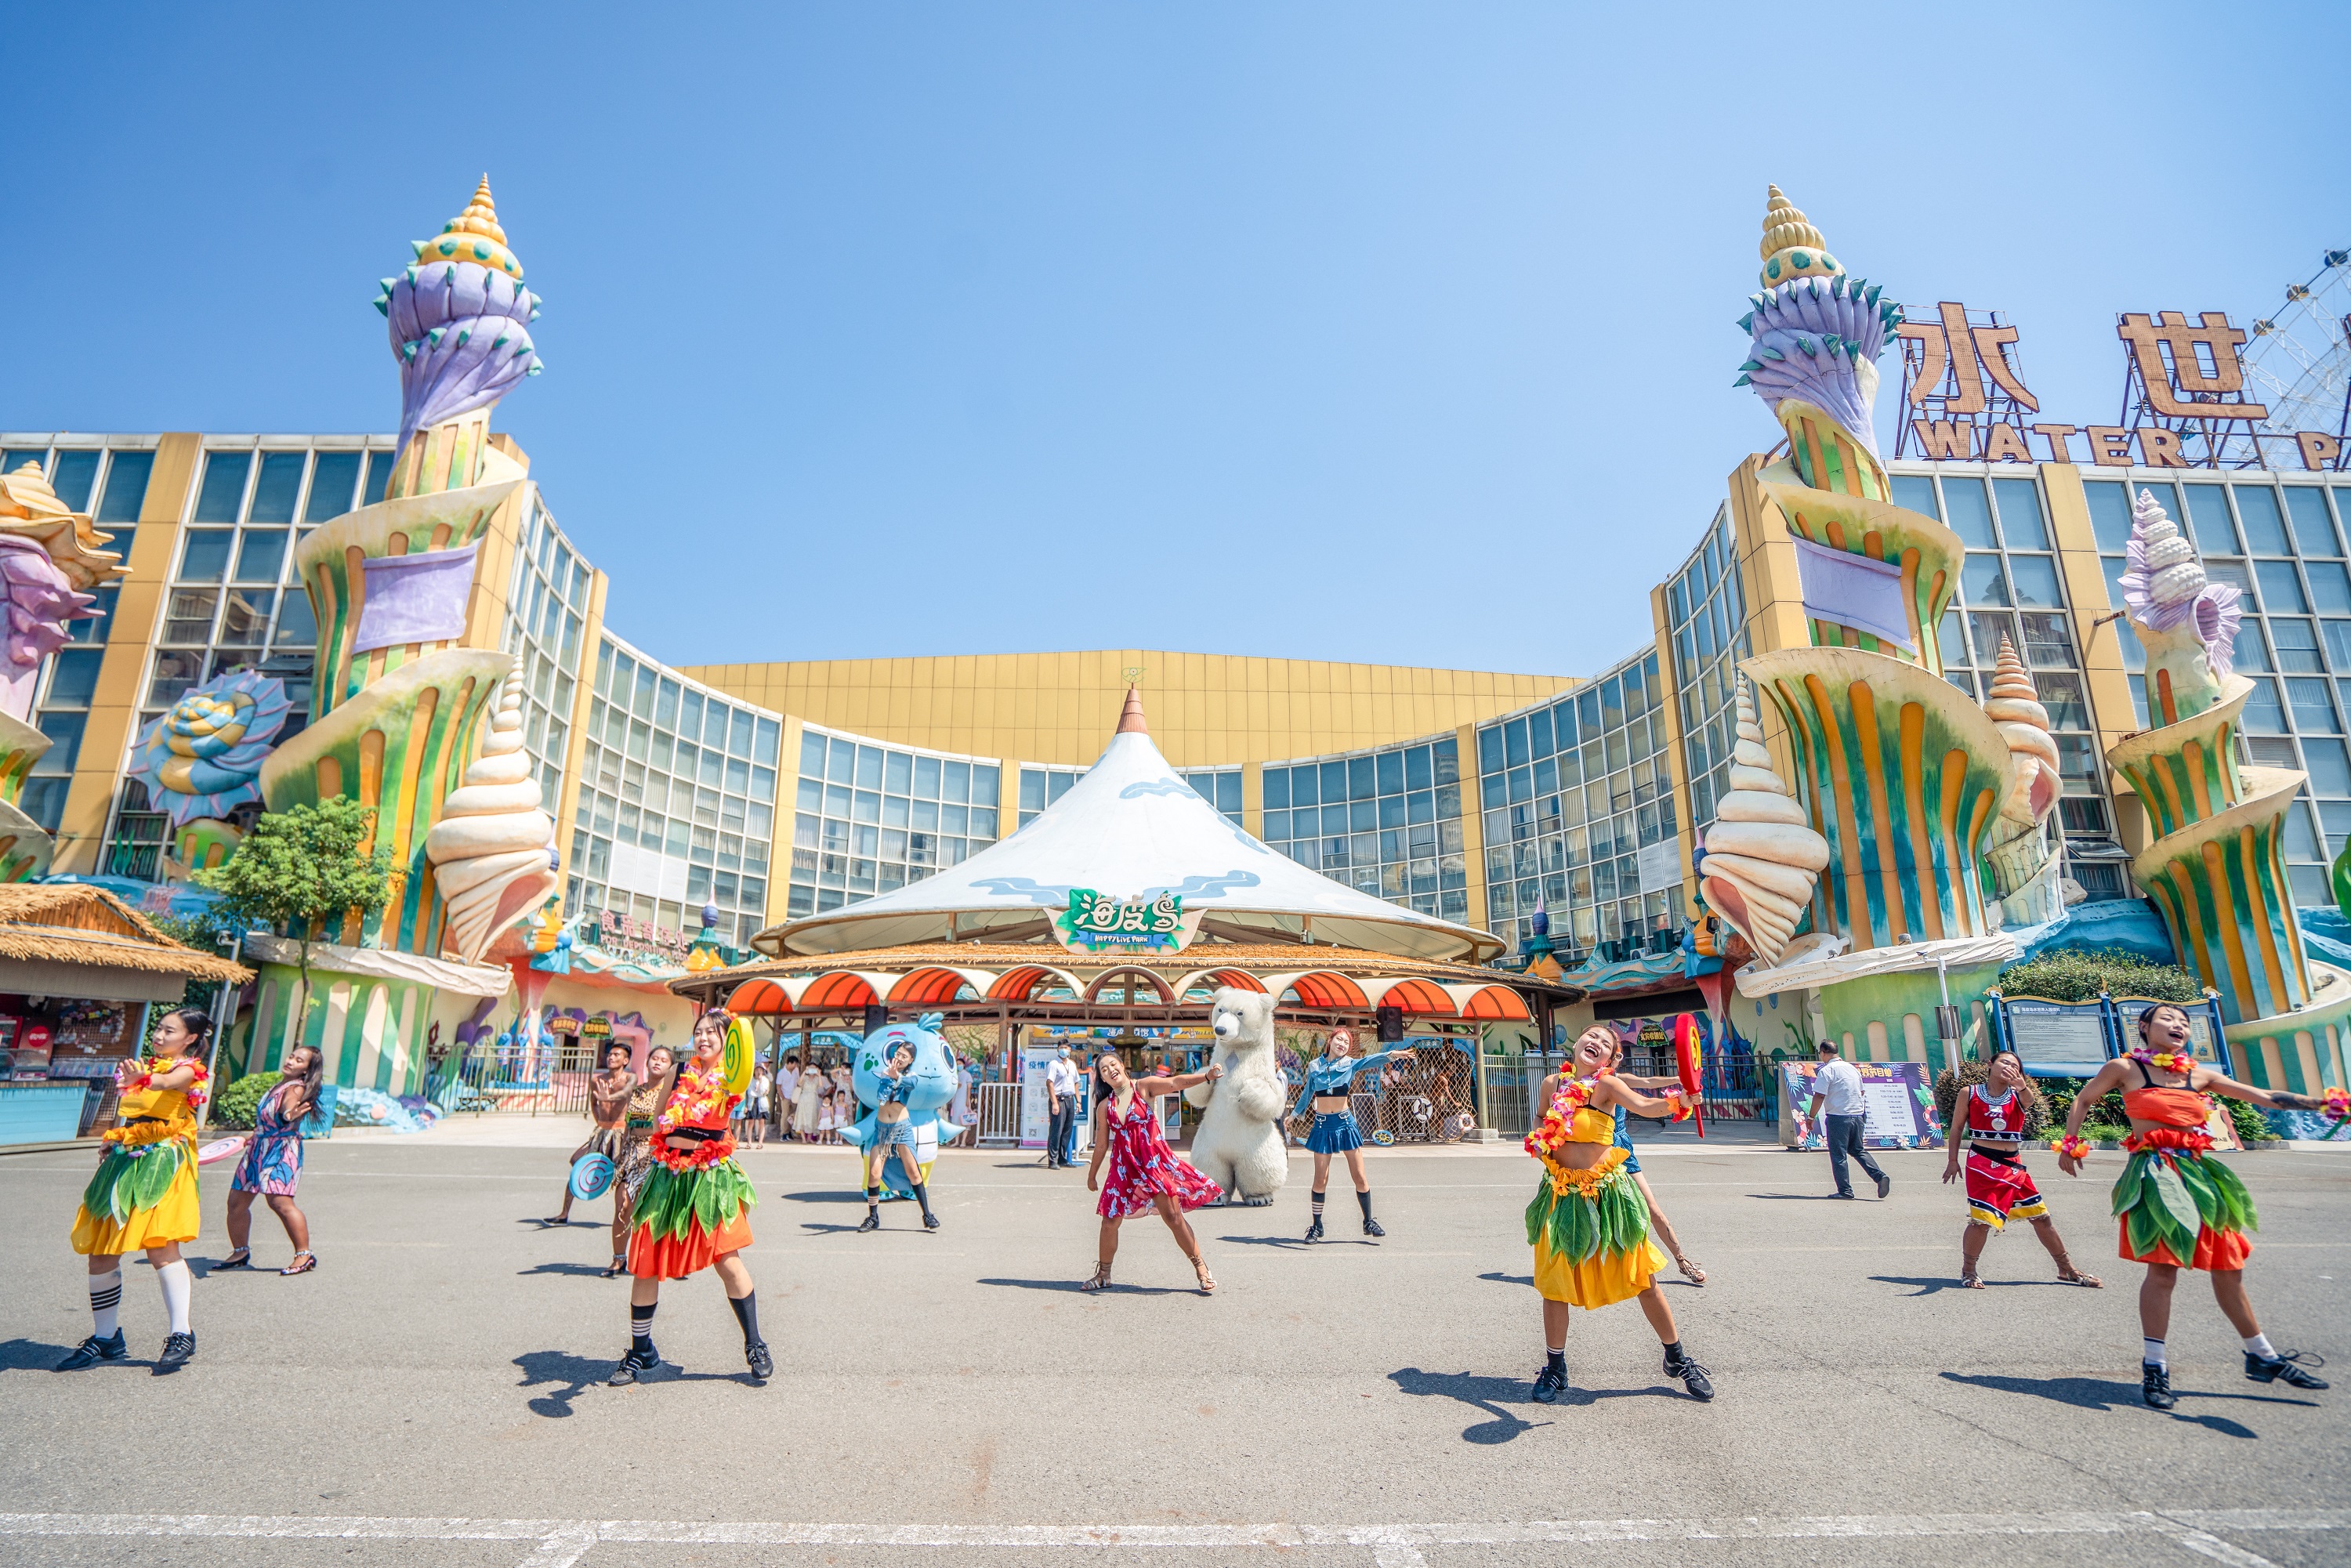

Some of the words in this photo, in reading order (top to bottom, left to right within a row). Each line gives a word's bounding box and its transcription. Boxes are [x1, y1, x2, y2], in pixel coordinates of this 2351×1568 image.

[1912, 418, 2193, 468] WATER
[600, 910, 687, 951] 食品寄存处
[601, 934, 618, 946] FOR
[623, 939, 668, 956] DEPOSITING
